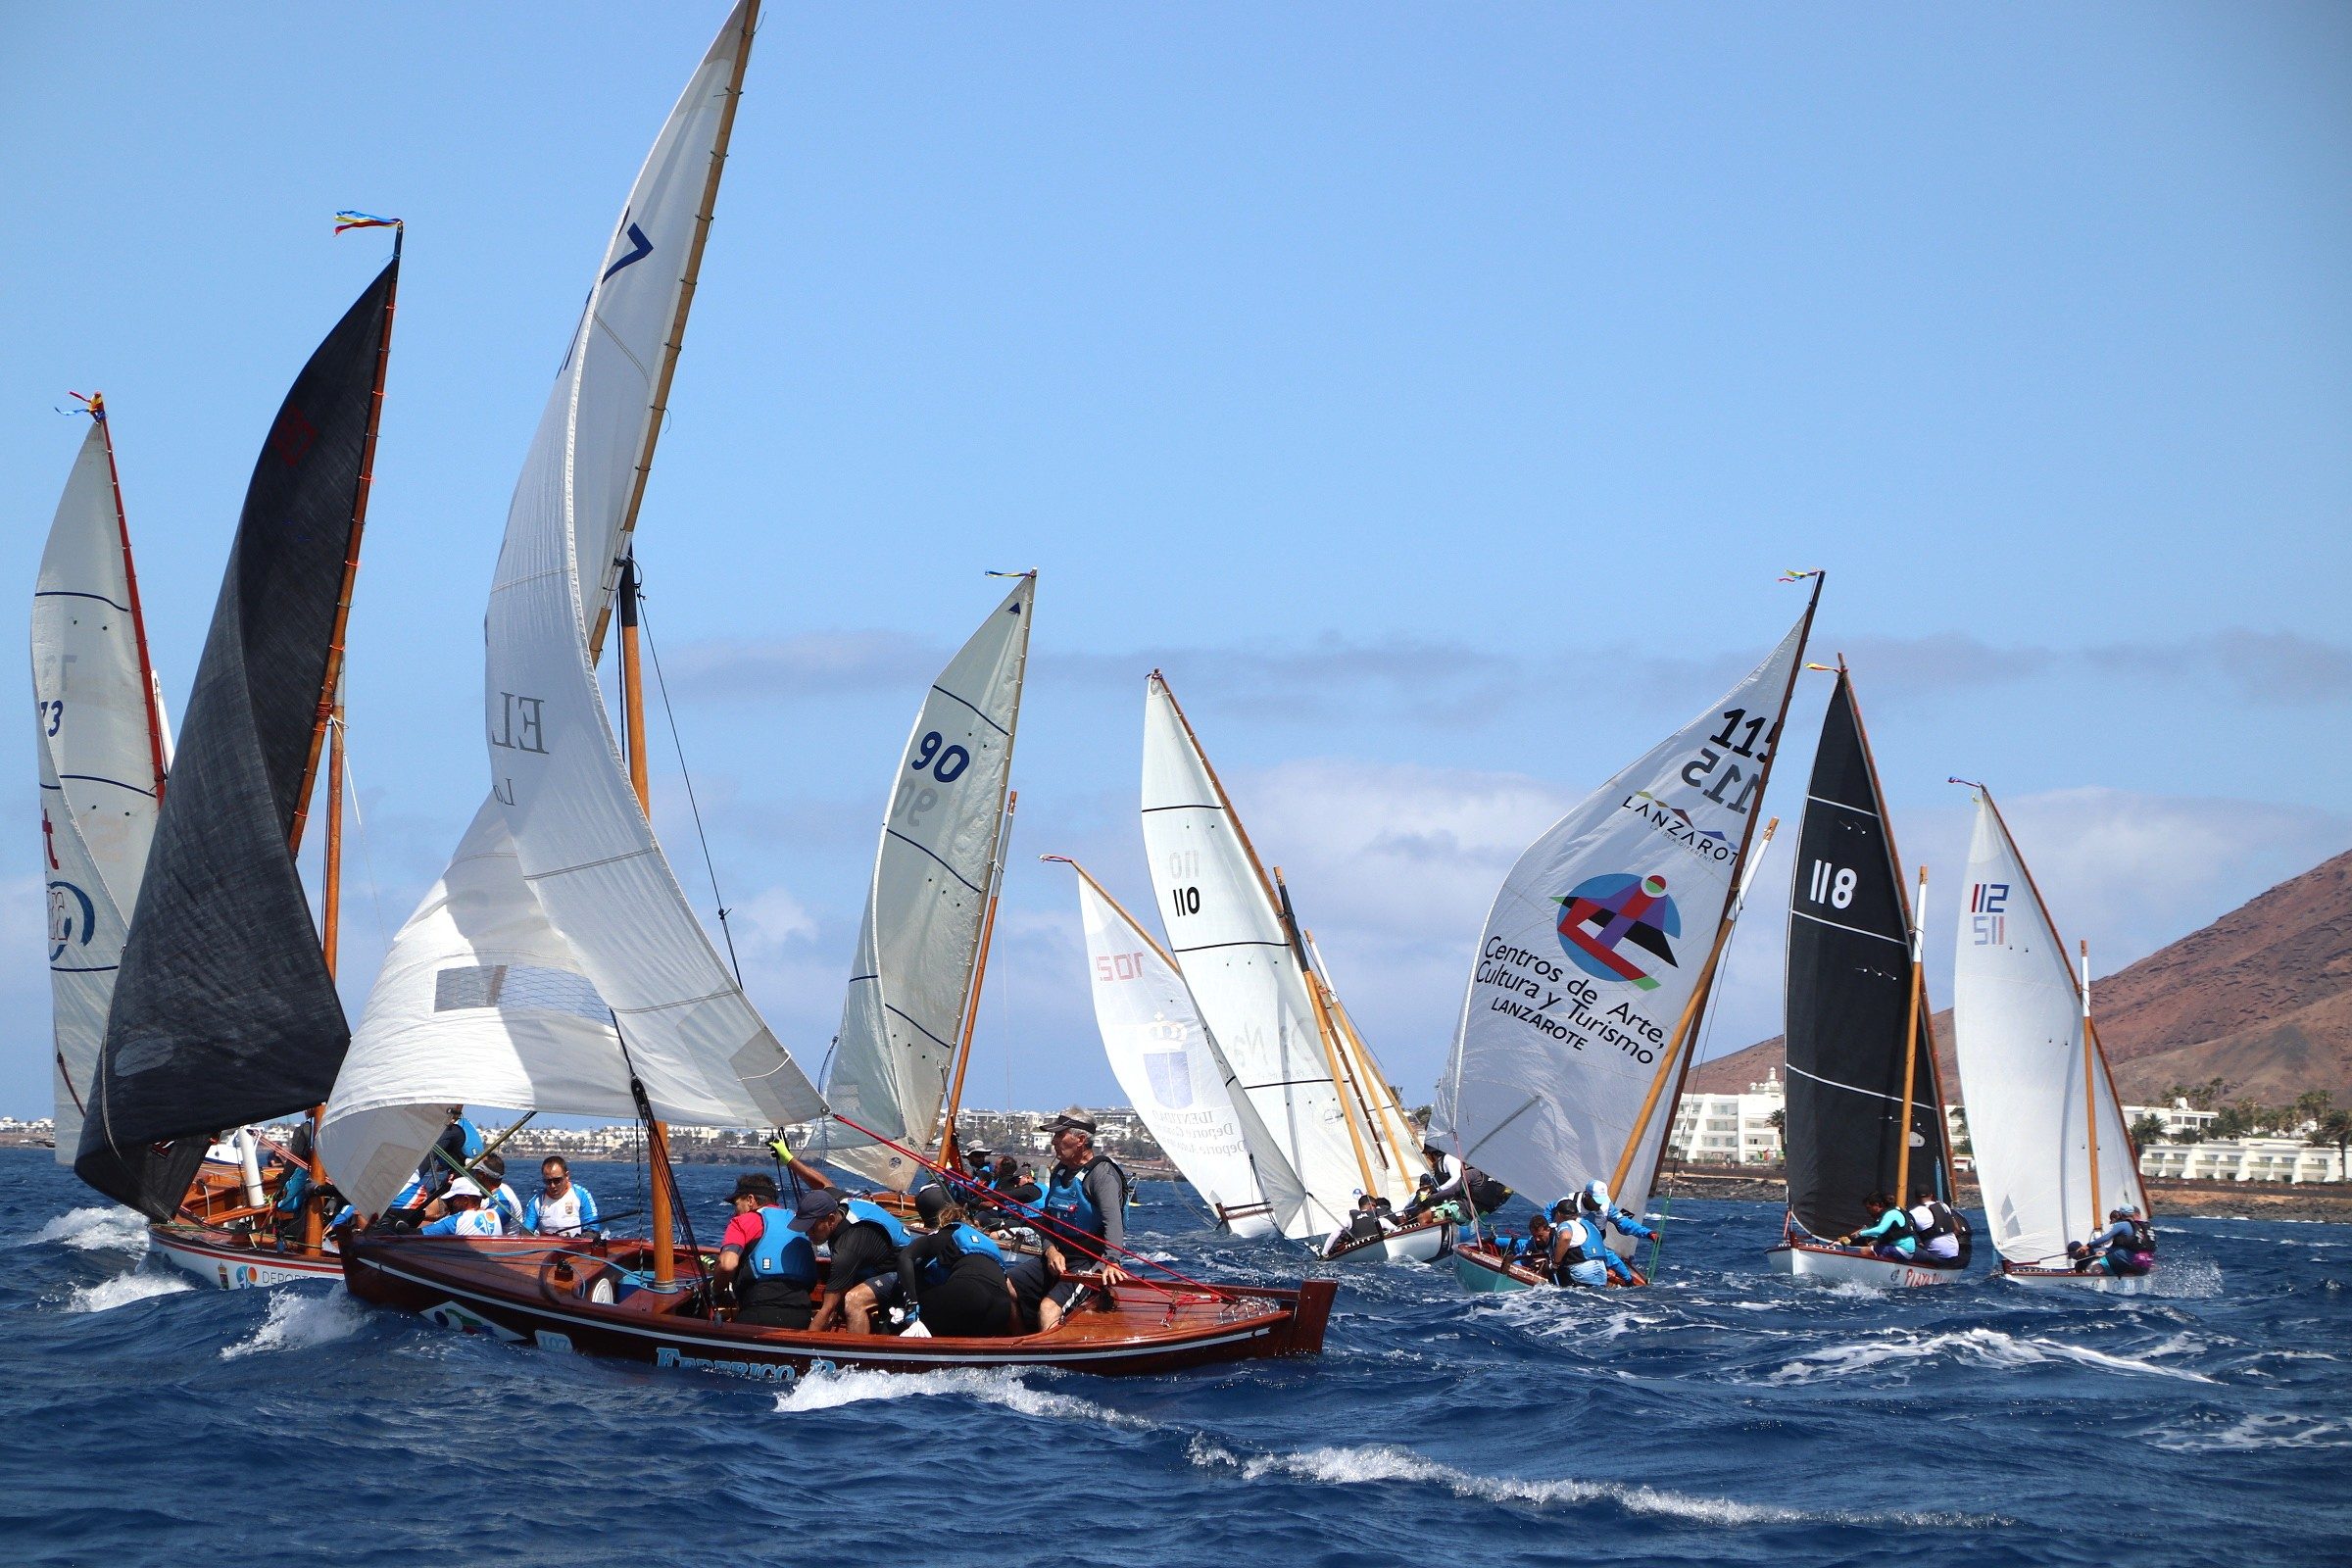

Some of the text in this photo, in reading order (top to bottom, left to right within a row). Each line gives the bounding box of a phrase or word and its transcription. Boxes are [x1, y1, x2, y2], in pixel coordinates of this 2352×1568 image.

[910, 730, 970, 783] 90
[1173, 886, 1200, 917] 110
[1810, 858, 1858, 909] 118
[1971, 883, 2010, 913] 112
[1476, 960, 1654, 1064] Cultura y Turismo
[1485, 936, 1665, 1050] Centros de Arte,
[1491, 997, 1589, 1052] LANZAROTE
